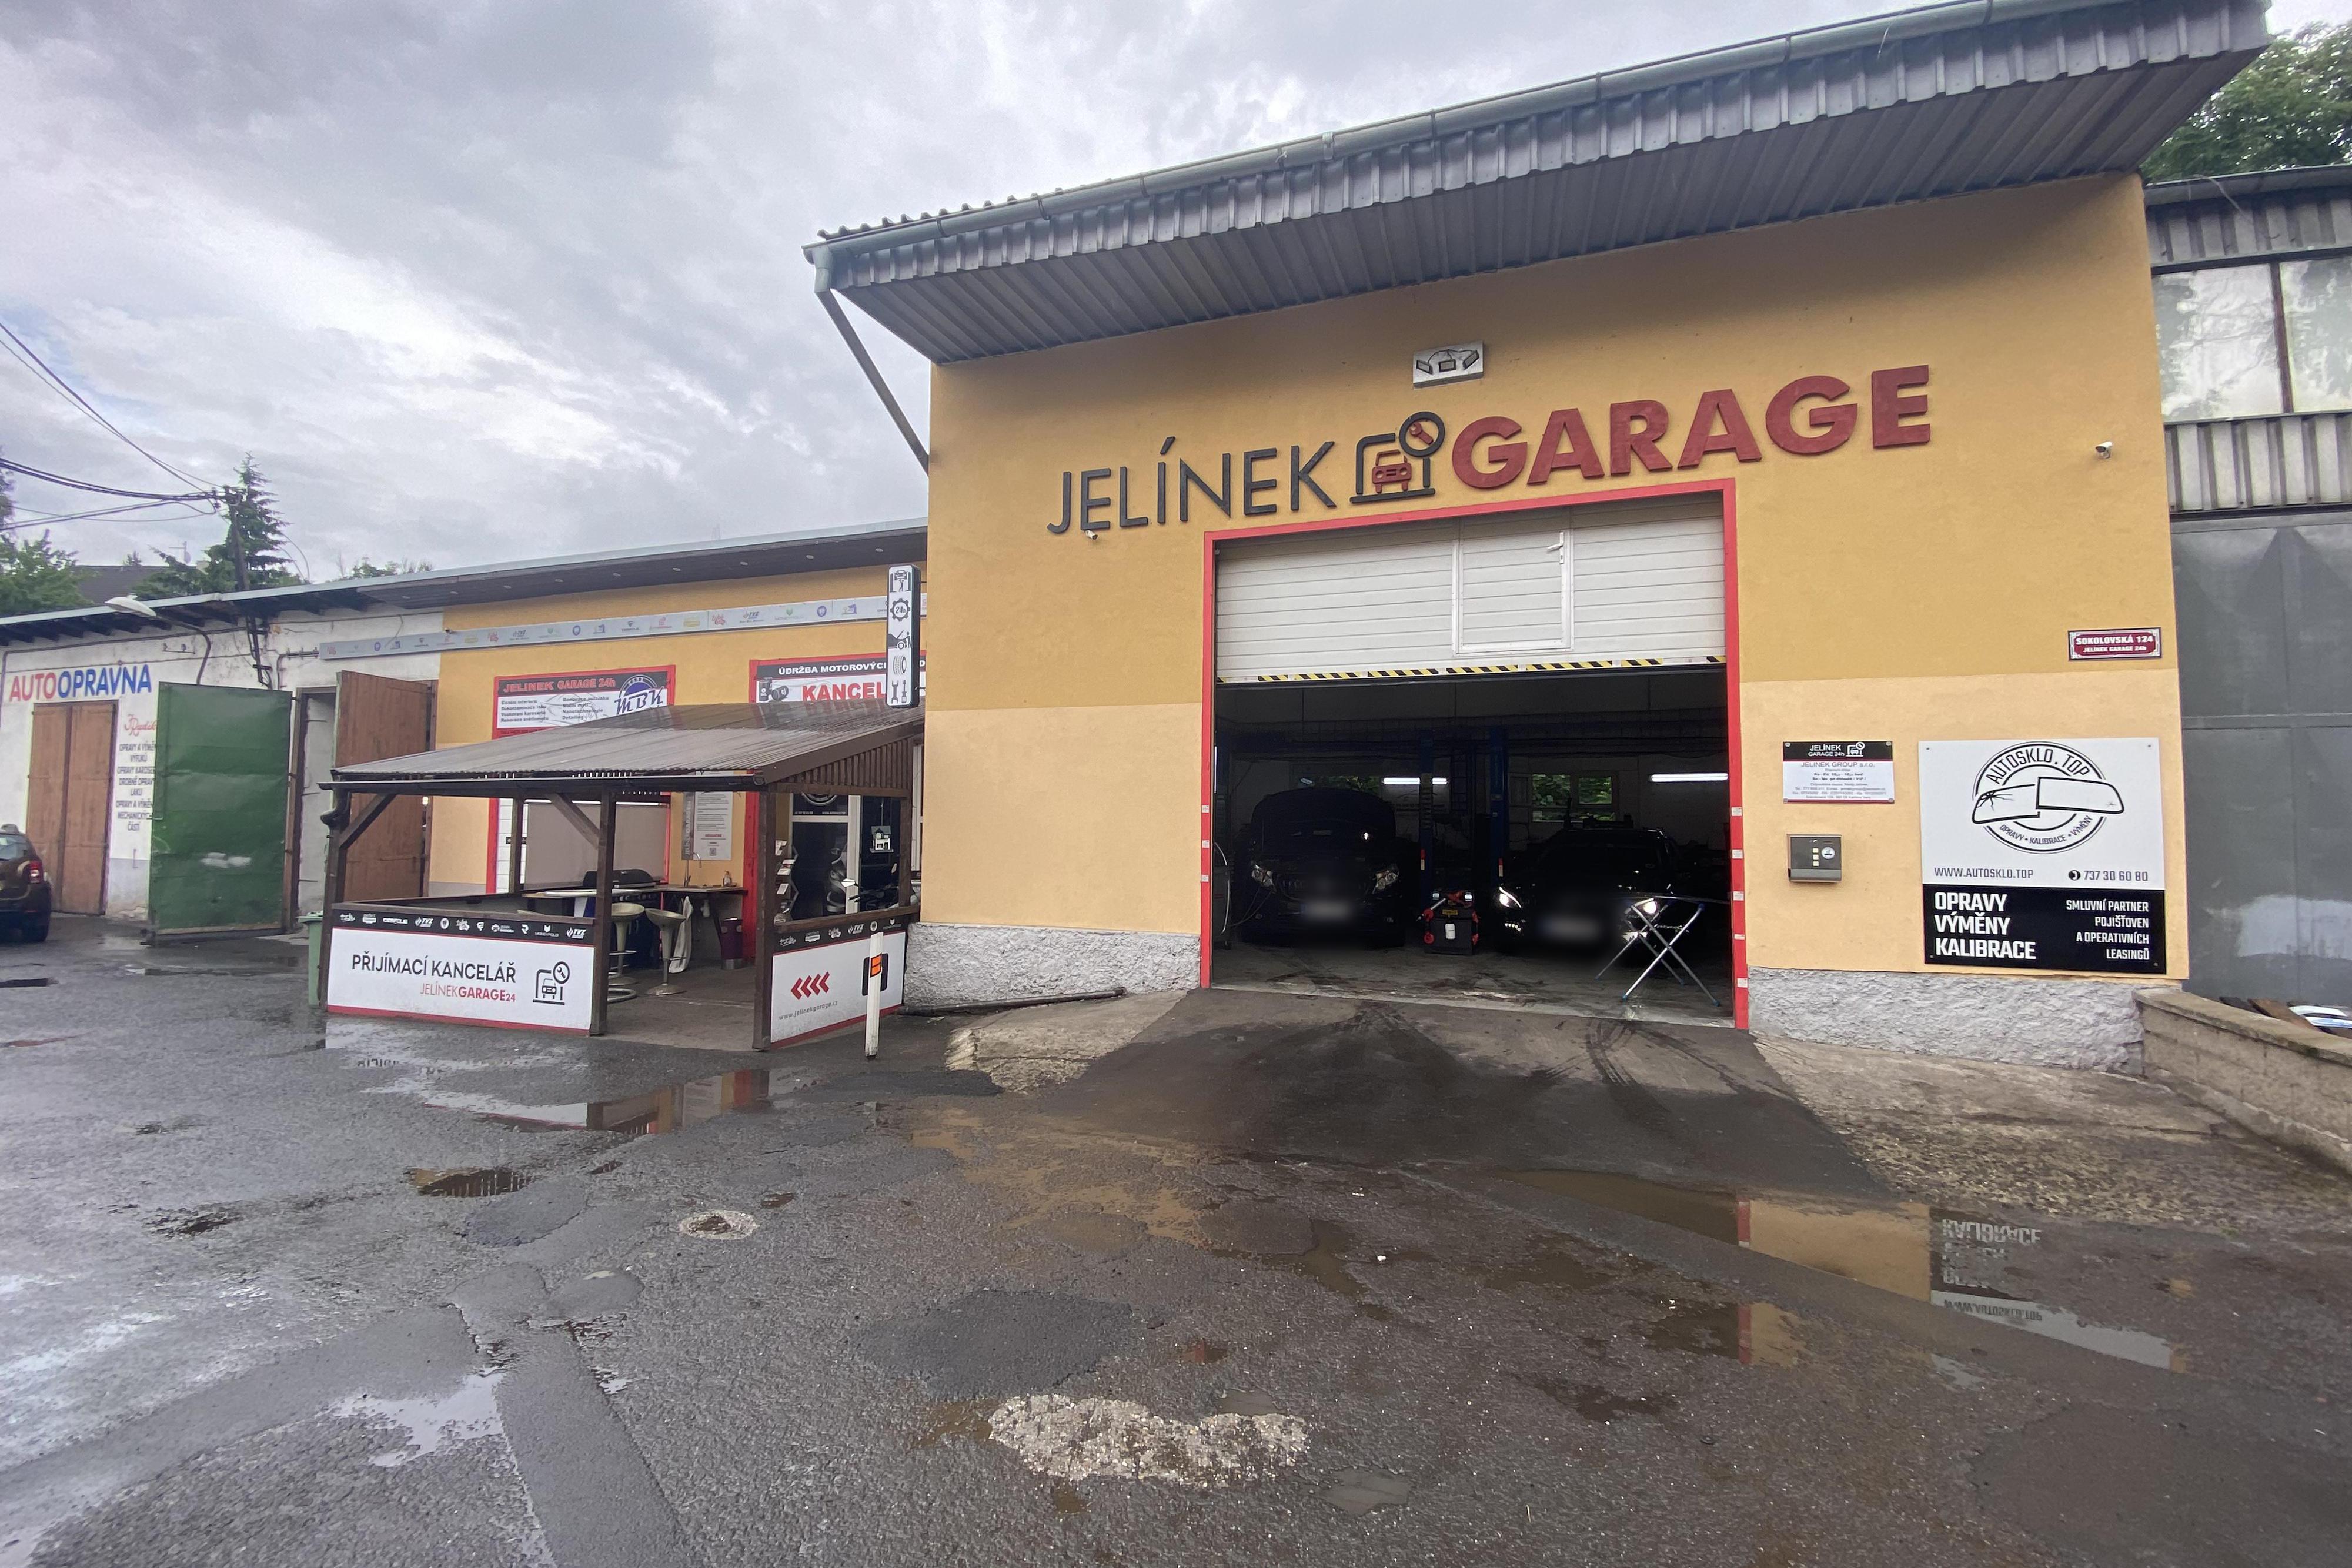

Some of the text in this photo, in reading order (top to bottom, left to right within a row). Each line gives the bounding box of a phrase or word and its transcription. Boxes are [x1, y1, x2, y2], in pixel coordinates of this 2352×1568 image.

[1047, 365, 1930, 534] JELÍNEK GARAGE
[895, 606, 906, 614] 24h
[2076, 634, 2134, 646] SOKOLOVSKÁ
[779, 664, 818, 675] ÚDRŽBA
[9, 664, 152, 702] AUTOOPRAVNA
[503, 681, 553, 693] JELINEK
[557, 678, 596, 690] GARAGE
[598, 678, 616, 688] 24h
[803, 681, 886, 702] KANCEL
[119, 743, 137, 752] OPRAVY
[138, 743, 141, 751] A
[1999, 815, 2093, 845] OPRAVY KALIBRACE VÝMĚNY
[1934, 867, 2033, 879] WWW.AUTOSKLO.TOP
[2084, 871, 2148, 881] 737 30 60 80
[1935, 892, 2007, 912] OPRAVY
[2066, 898, 2149, 912] SMLUVNÍ PARTNER
[1934, 911, 2010, 935] VÝMĚNY
[2094, 915, 2149, 928] POJIŠŤOVEN
[2076, 931, 2150, 945] A OPERATIVNÍCH
[1935, 937, 2037, 960] KALIBRACE
[2106, 947, 2150, 961] LEASINGŮ
[352, 951, 516, 984] PŘIJÍMACÍ KANCELÁŘ
[420, 981, 516, 1002] JELÍNEKGARAGE24
[779, 1001, 838, 1021] www.jelinekgarage.cz
